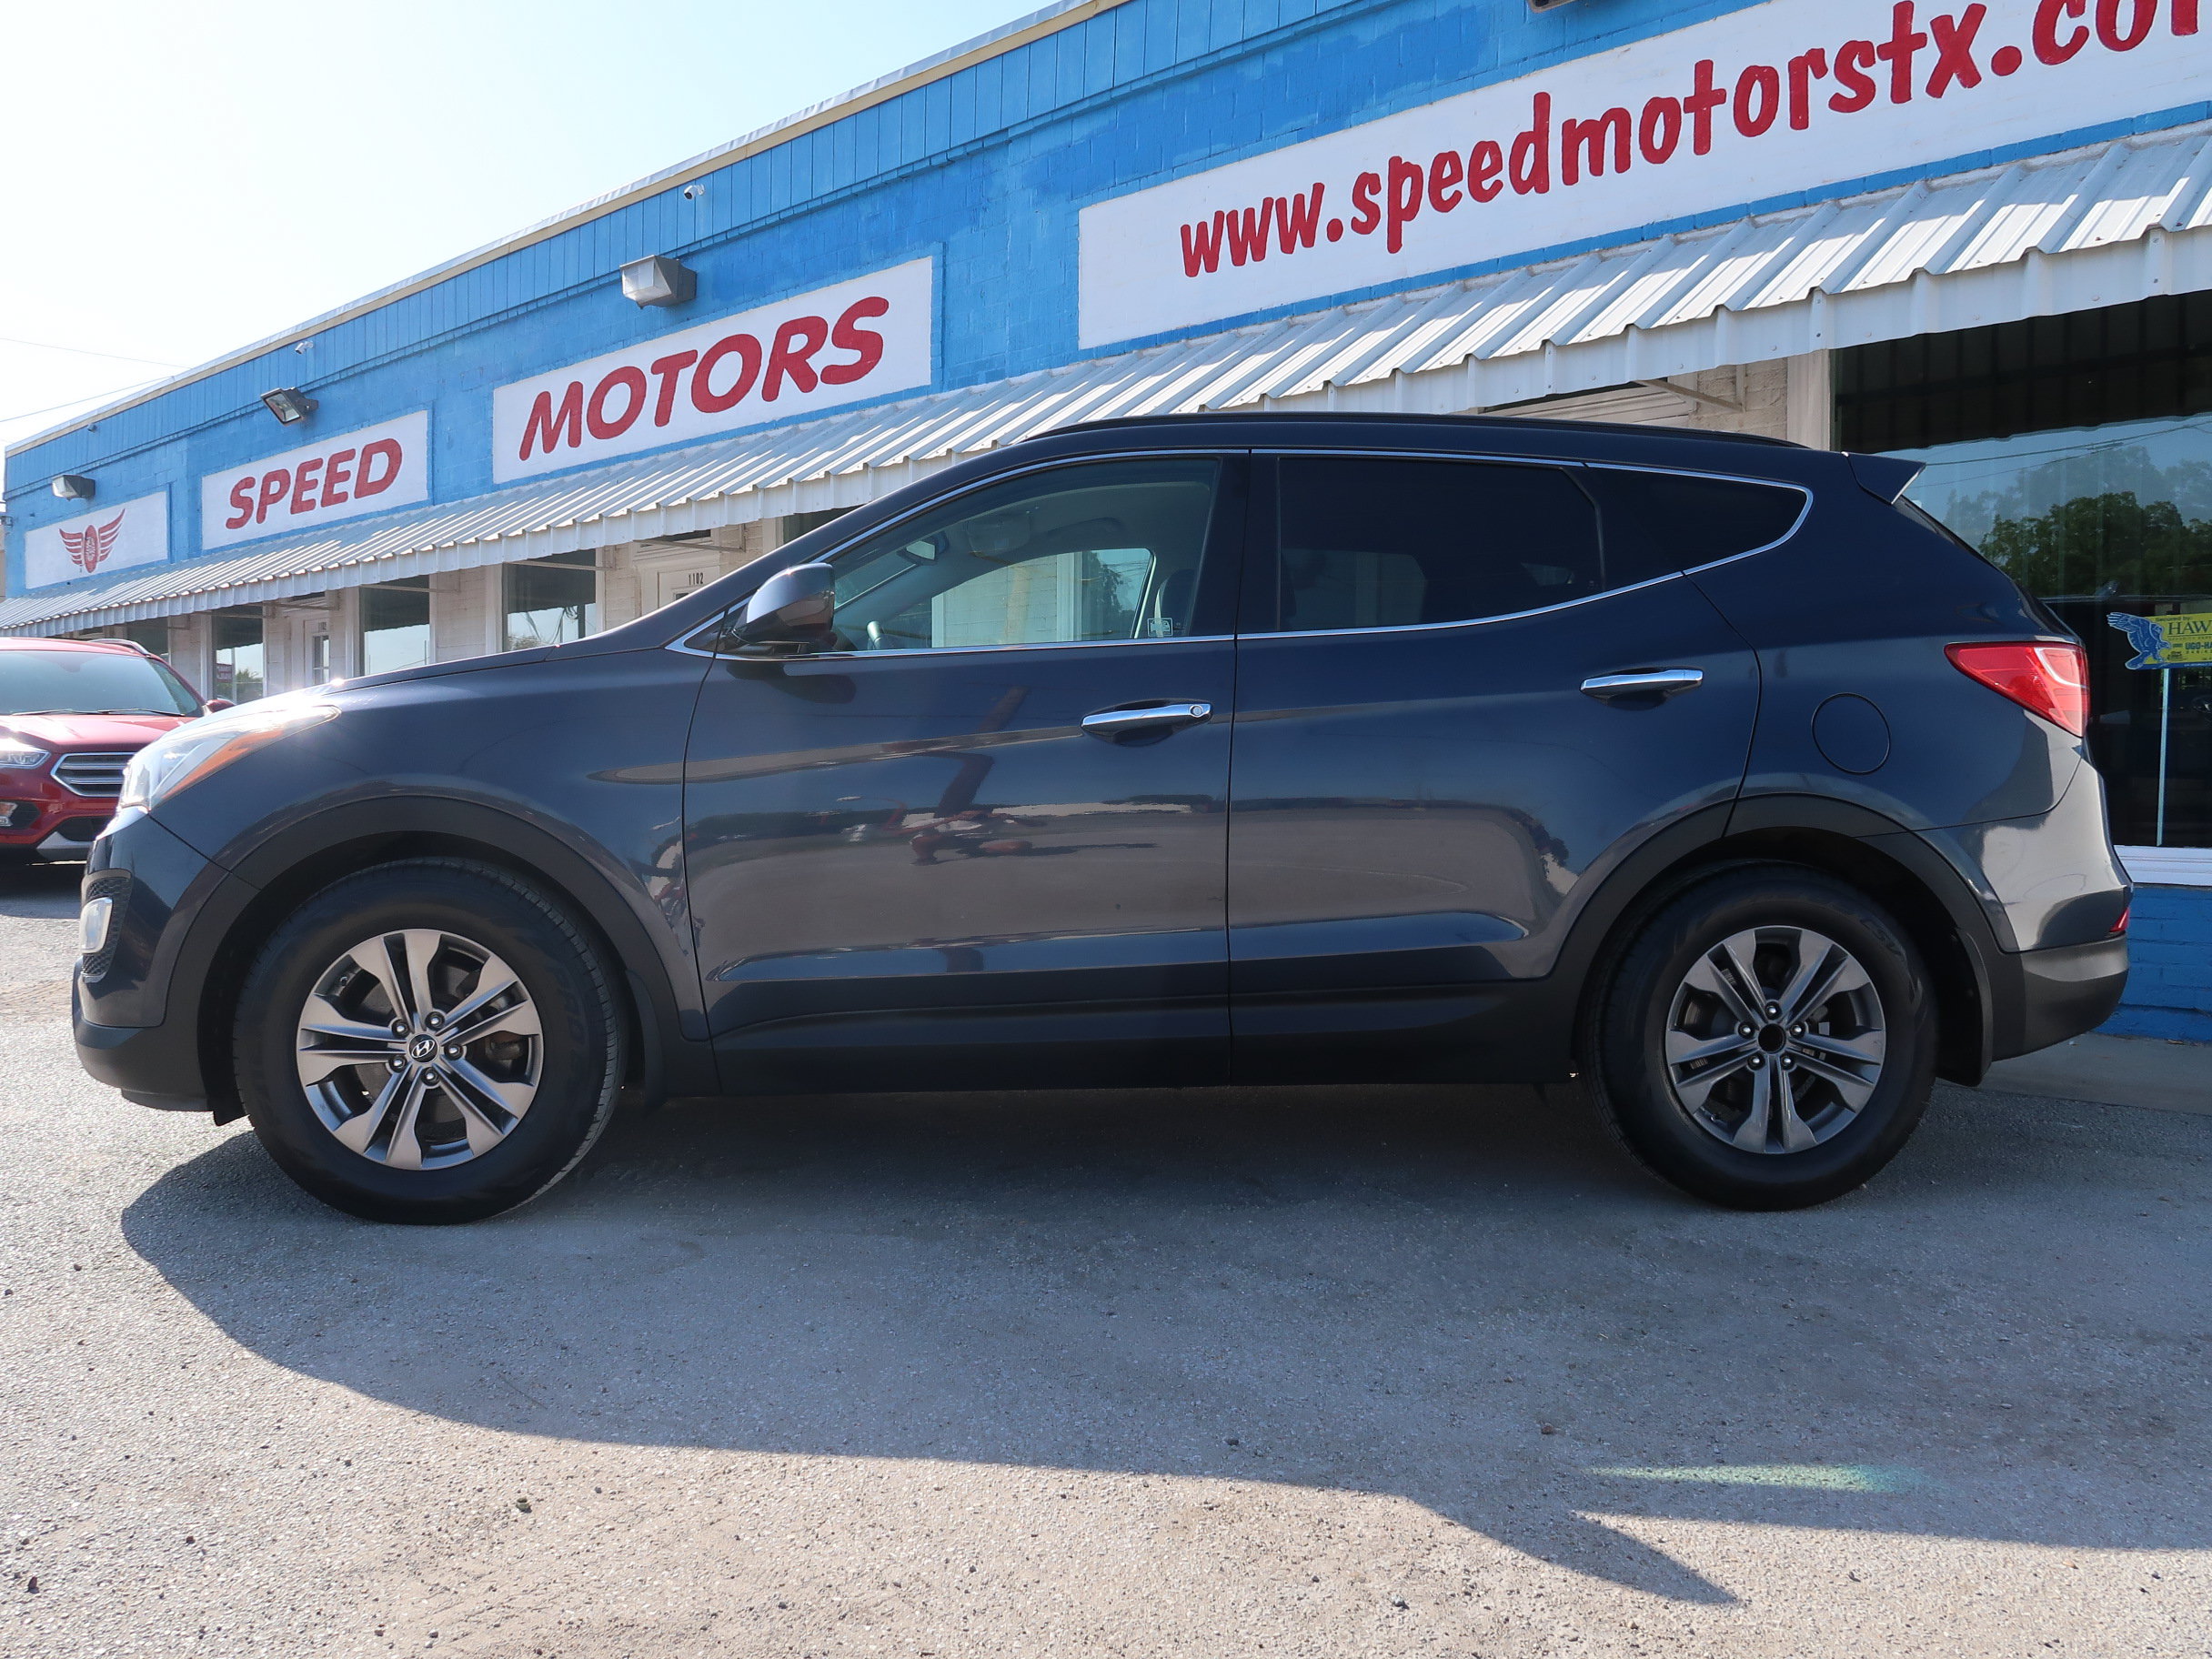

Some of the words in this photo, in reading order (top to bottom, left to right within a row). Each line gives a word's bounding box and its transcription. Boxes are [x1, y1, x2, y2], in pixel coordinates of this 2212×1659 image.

[1180, 0, 2199, 278] www.speedmotorstx.co
[519, 297, 890, 461] MOTORS
[226, 437, 403, 529] SPEED
[689, 572, 704, 585] 1102
